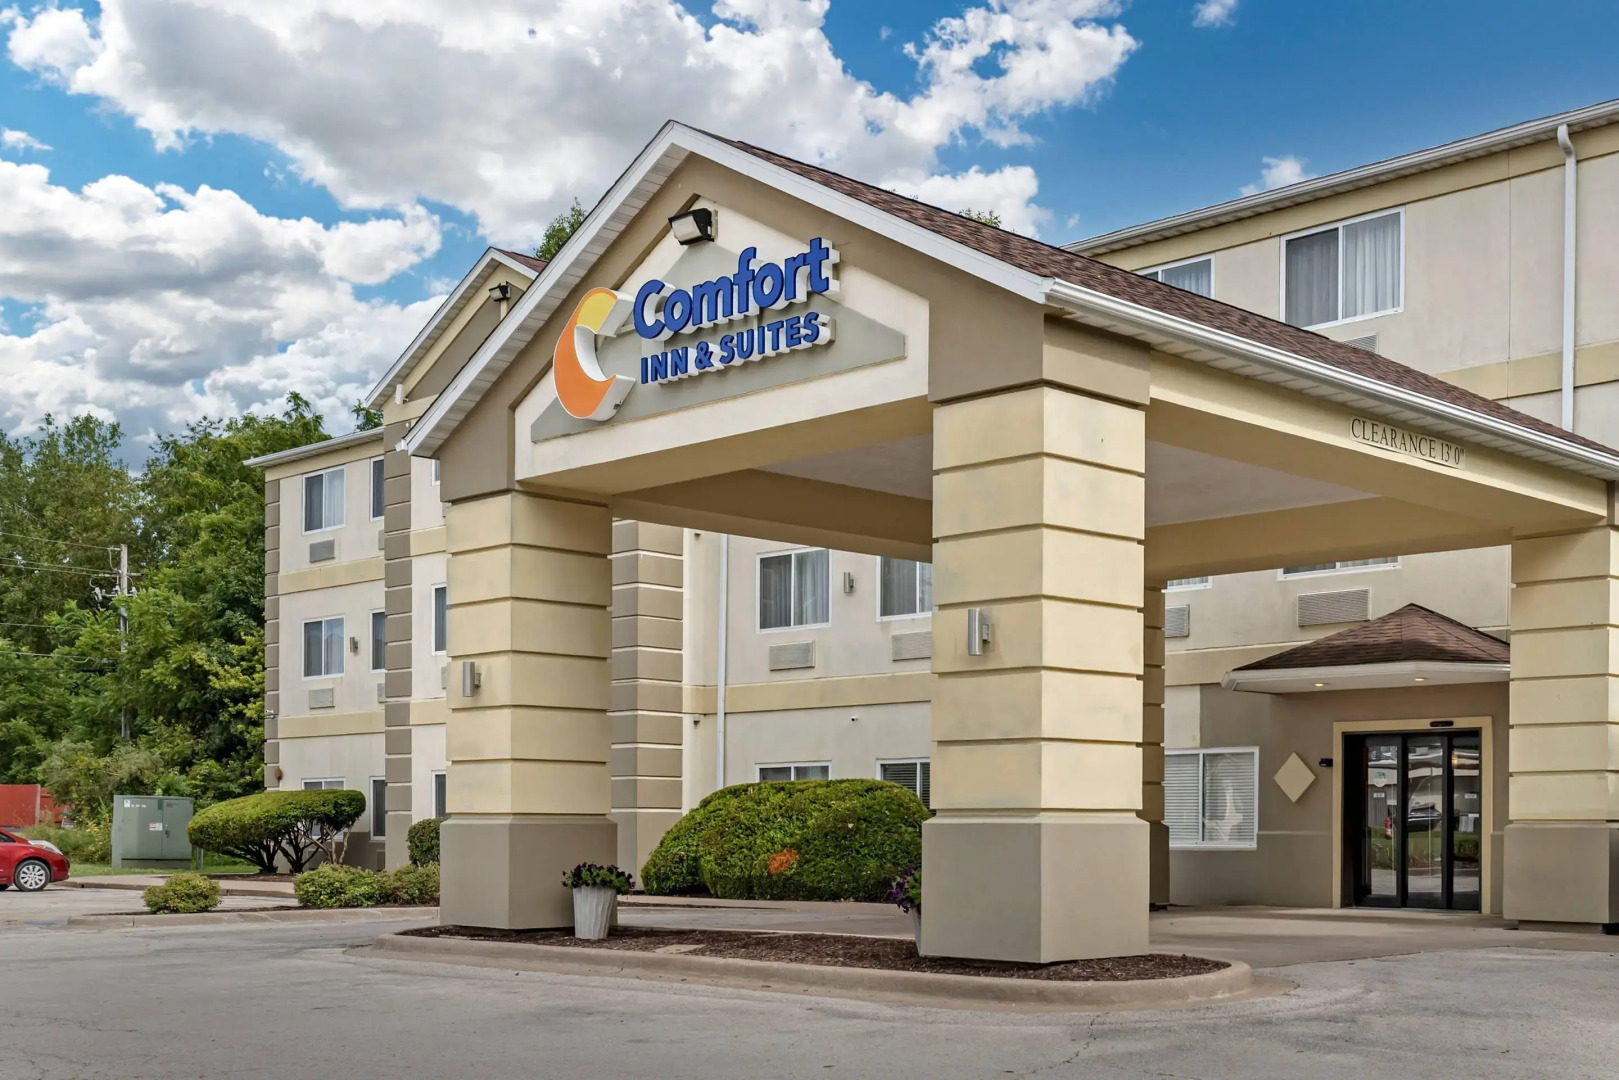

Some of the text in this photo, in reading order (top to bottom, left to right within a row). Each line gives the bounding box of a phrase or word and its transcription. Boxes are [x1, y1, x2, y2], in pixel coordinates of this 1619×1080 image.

[633, 237, 830, 339] Comfort
[641, 312, 820, 384] INN & SUITES
[1351, 418, 1437, 459] CLEARANCE
